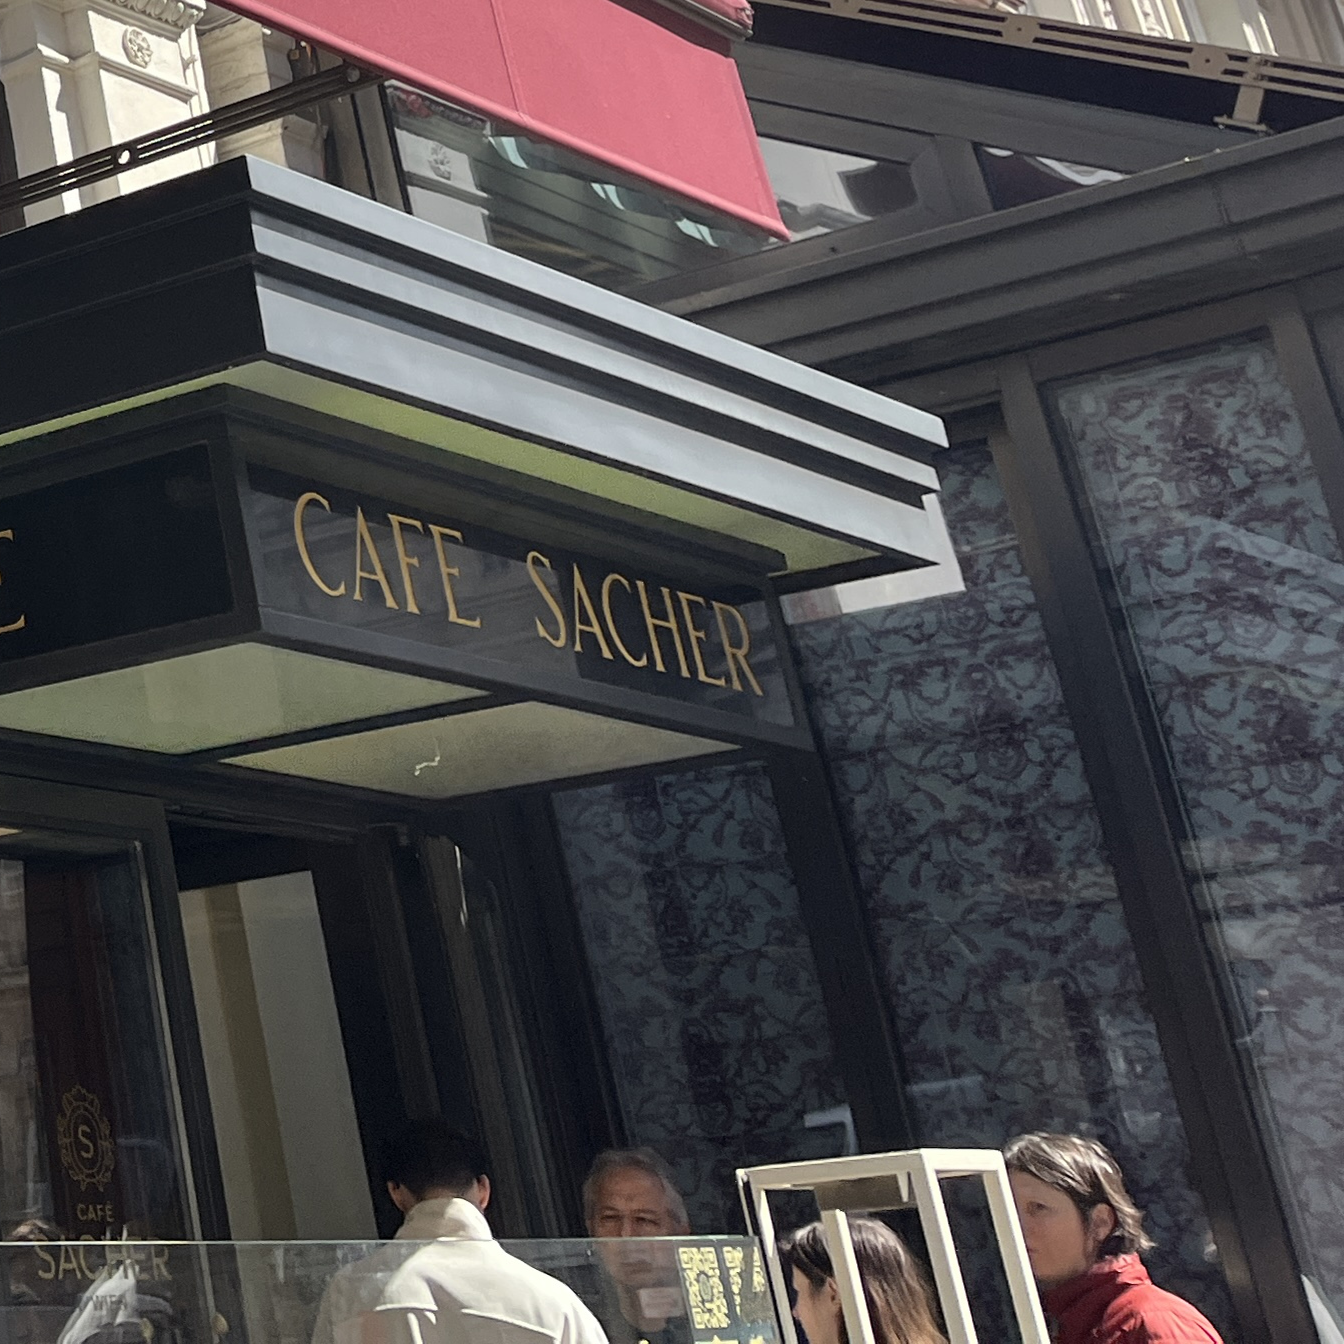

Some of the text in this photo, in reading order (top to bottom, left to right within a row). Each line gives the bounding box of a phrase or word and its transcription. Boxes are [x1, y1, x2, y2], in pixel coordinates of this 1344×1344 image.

[293, 492, 763, 696] CAFE SACHER
[78, 1126, 94, 1159] S
[33, 1233, 172, 1280] SACHER
